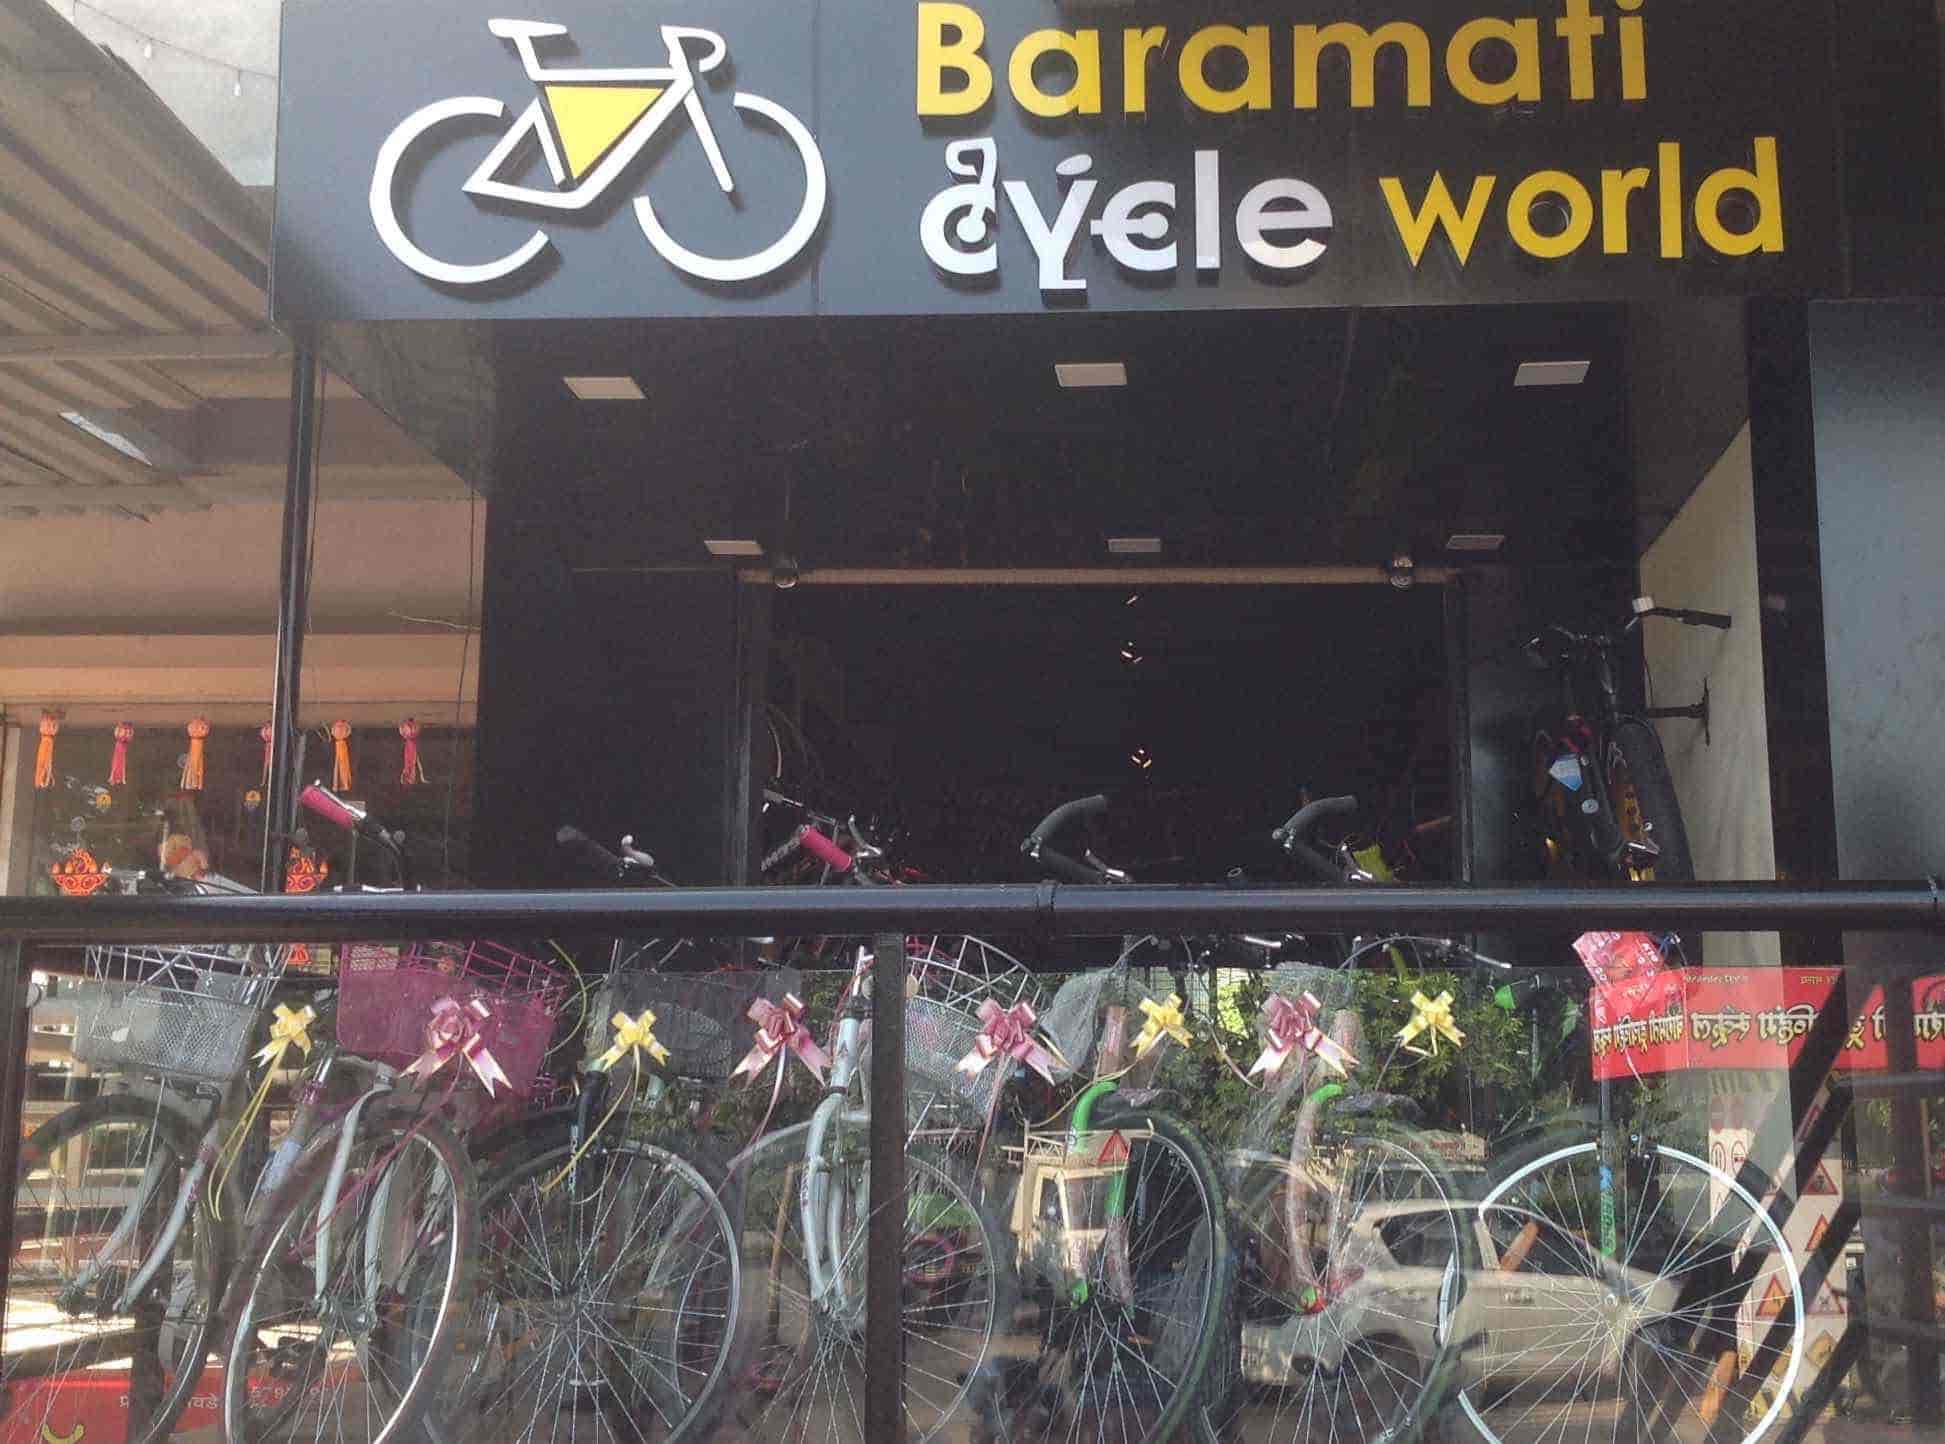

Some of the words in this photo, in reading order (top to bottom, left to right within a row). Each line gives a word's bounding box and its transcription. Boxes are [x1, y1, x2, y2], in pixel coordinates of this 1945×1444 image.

[915, 0, 1650, 118] Baramati
[919, 136, 1334, 298] cycle
[1379, 136, 1785, 268] world
